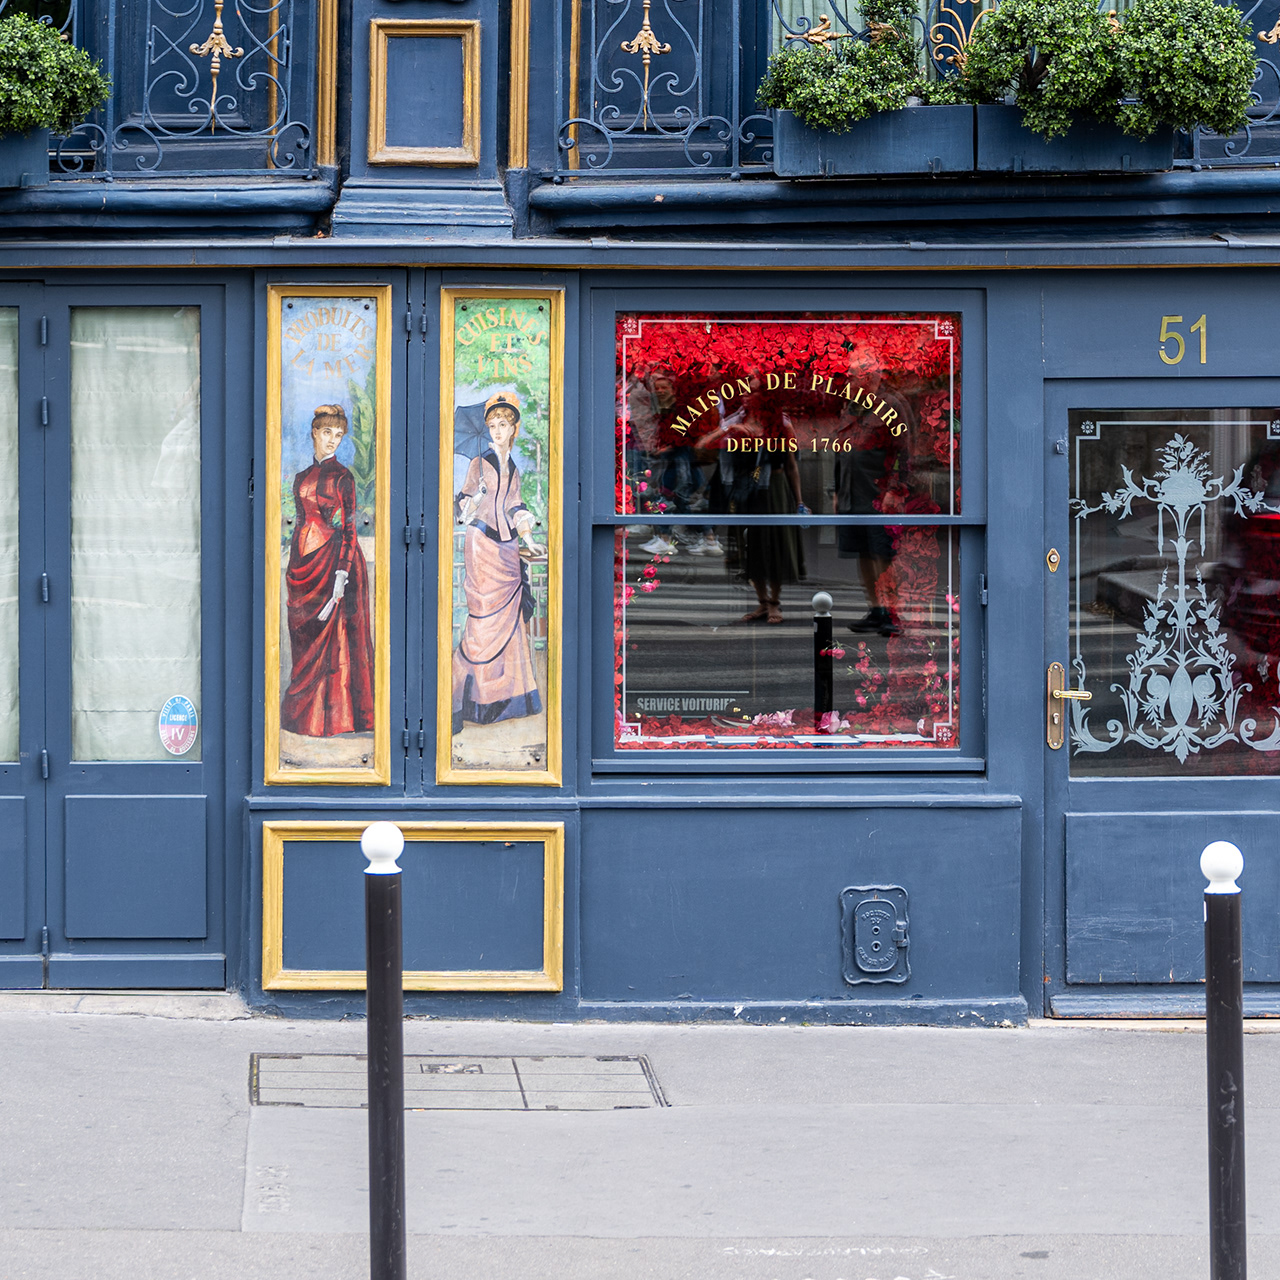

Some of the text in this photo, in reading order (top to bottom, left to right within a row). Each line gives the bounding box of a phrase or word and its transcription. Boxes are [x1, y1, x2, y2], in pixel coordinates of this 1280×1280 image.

[284, 307, 374, 345] PRODUITS
[456, 307, 548, 346] CUISINES
[316, 332, 342, 352] DE
[489, 333, 516, 352] ET
[1158, 314, 1207, 365] 51
[291, 343, 374, 380] LA MER
[477, 353, 532, 378] VINS
[670, 372, 908, 438] MAISON DE PLAISIRS
[726, 437, 852, 453] DEPUIS 1766
[637, 697, 680, 712] SERVICE
[169, 714, 188, 722] LICENCE
[171, 728, 186, 741] IV
